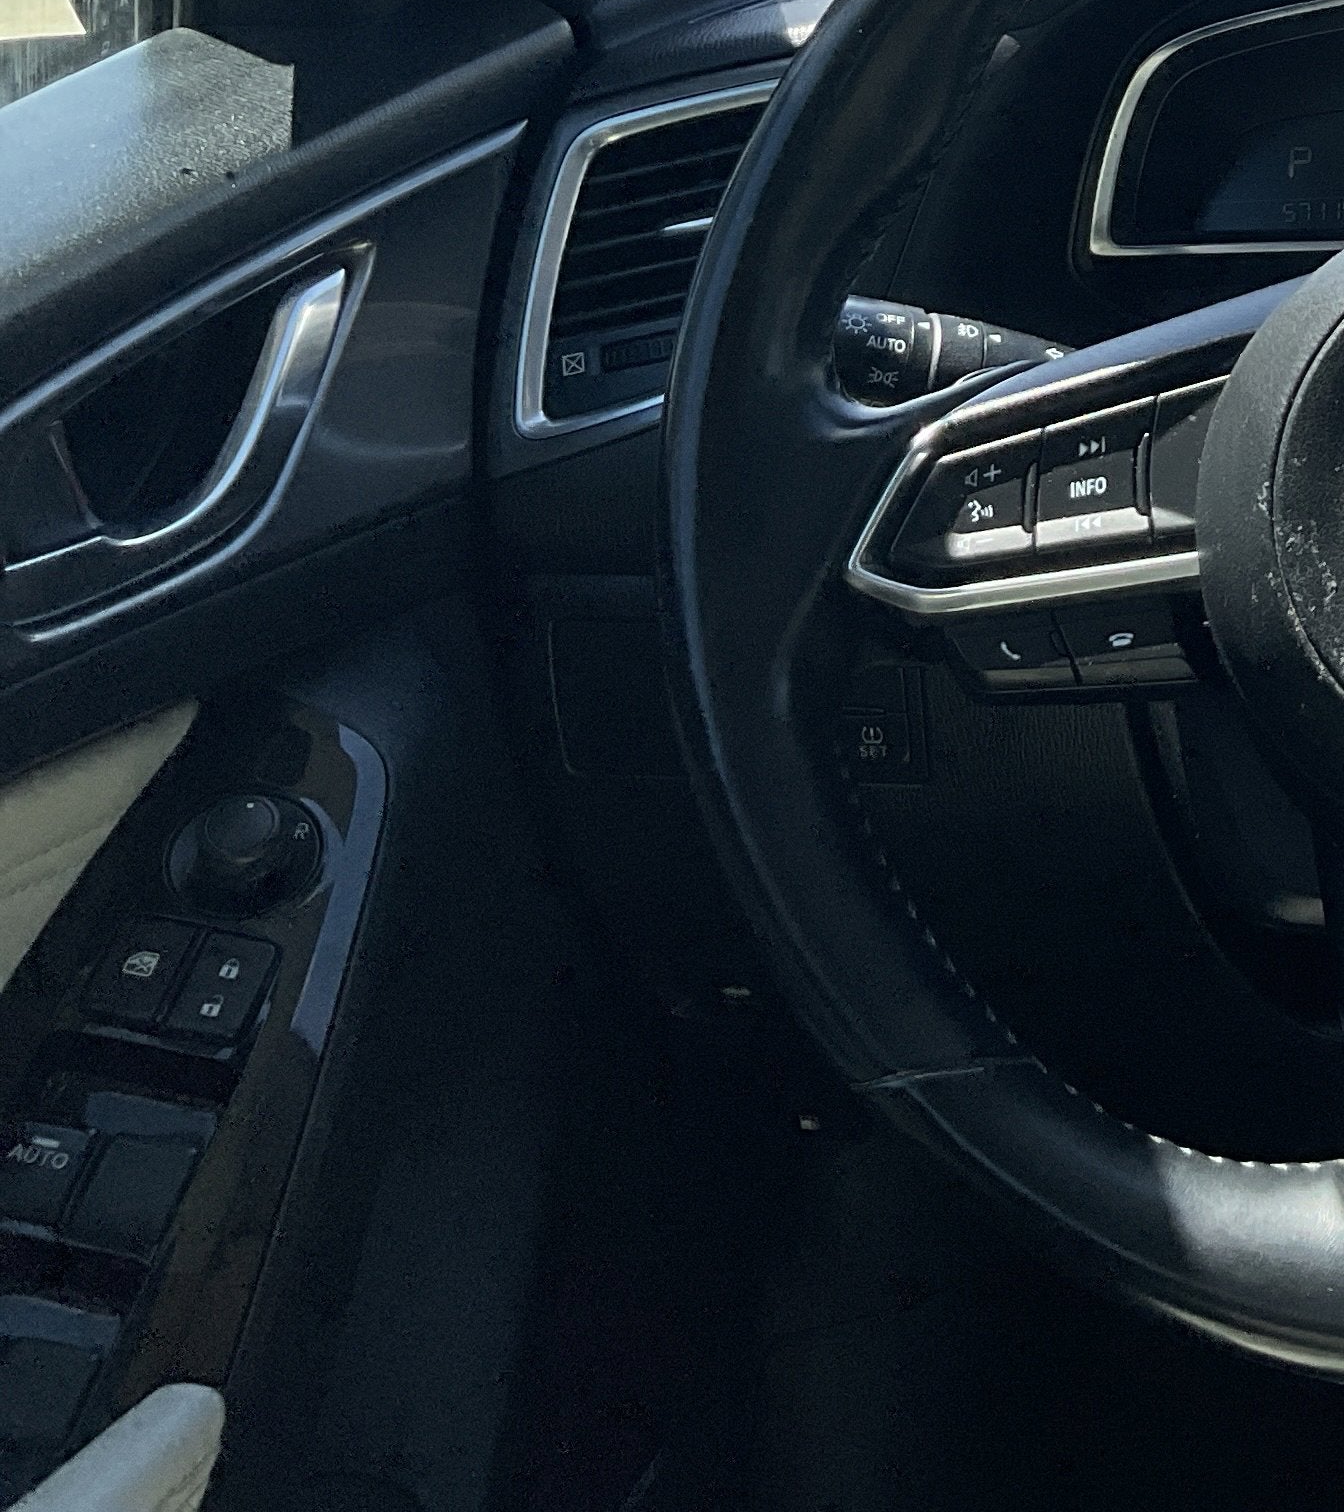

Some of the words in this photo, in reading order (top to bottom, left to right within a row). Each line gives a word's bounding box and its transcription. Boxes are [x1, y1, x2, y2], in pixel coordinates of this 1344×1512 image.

[1286, 145, 1313, 179] P
[876, 312, 906, 325] OFF
[866, 335, 906, 354] AUTO
[1070, 477, 1107, 499] INFO
[6, 1143, 70, 1171] AUTO
